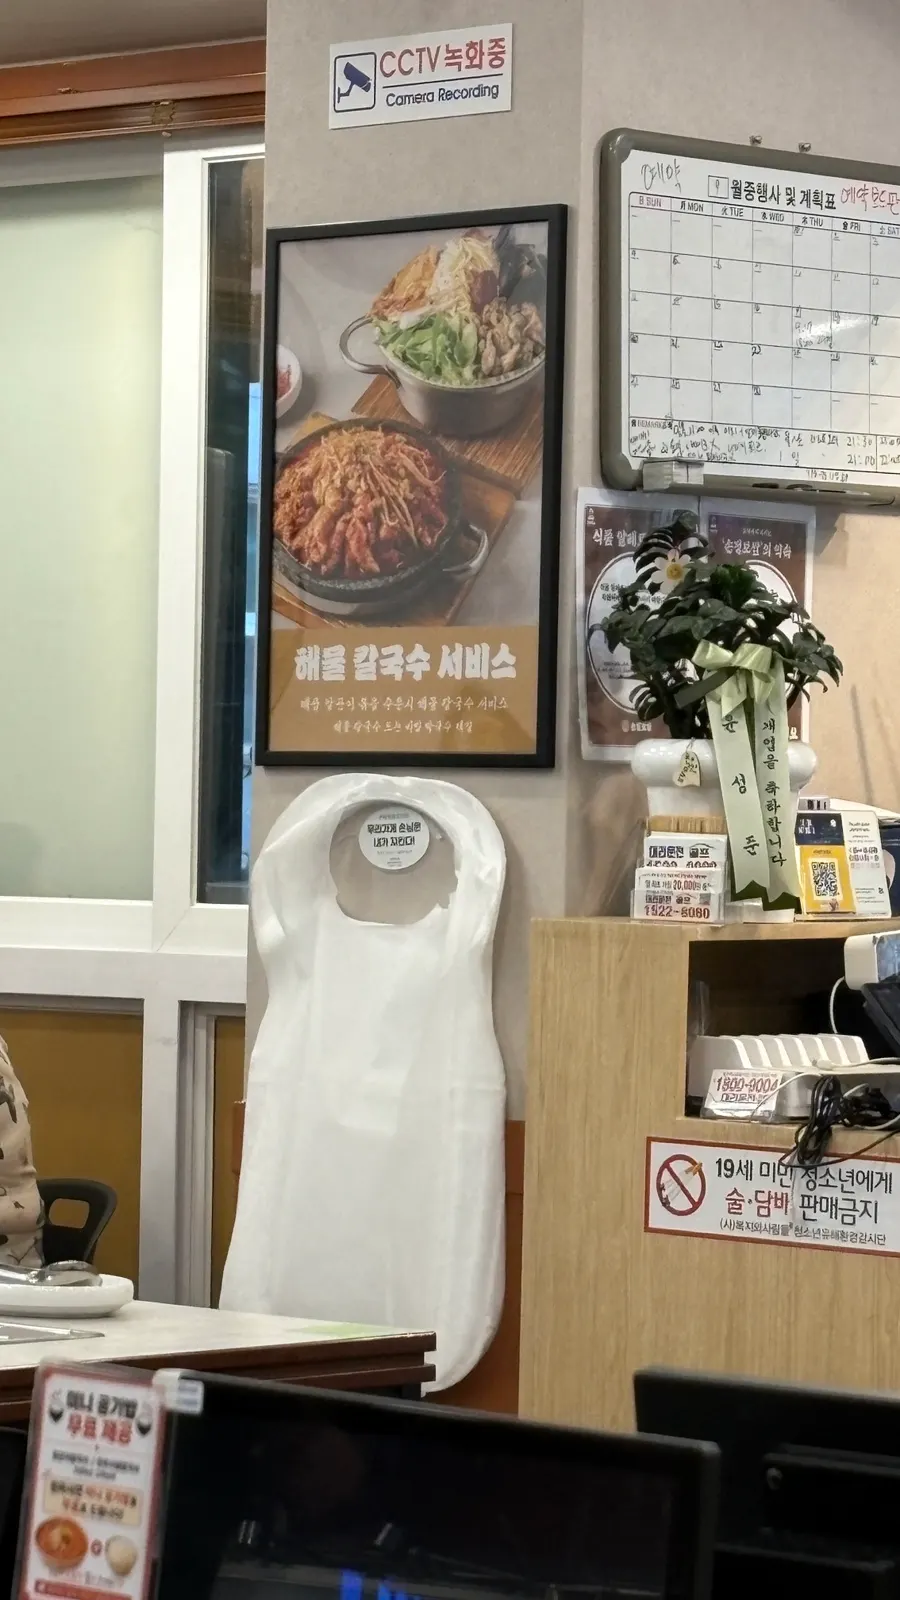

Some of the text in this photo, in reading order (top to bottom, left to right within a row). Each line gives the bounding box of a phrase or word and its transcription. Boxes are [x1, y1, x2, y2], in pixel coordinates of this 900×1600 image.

[386, 84, 500, 107] Camera Recording
[641, 158, 682, 194] 예약
[646, 196, 662, 207] SUN
[730, 179, 836, 210] 월중행사 및 계획표
[688, 201, 704, 212] MON
[729, 206, 744, 217] TUE
[769, 212, 785, 222] WED
[809, 217, 823, 227] THU
[850, 221, 860, 231] FRI
[887, 226, 900, 235] SAT
[593, 527, 614, 547] 식품
[294, 642, 517, 681] 해물 칼국수 서비스
[477, 695, 508, 711] 서비스
[762, 717, 788, 867] 개업을 축하합니다
[373, 837, 389, 848] 내가
[715, 1158, 753, 1182] 19세
[799, 1194, 879, 1226] 판매금지
